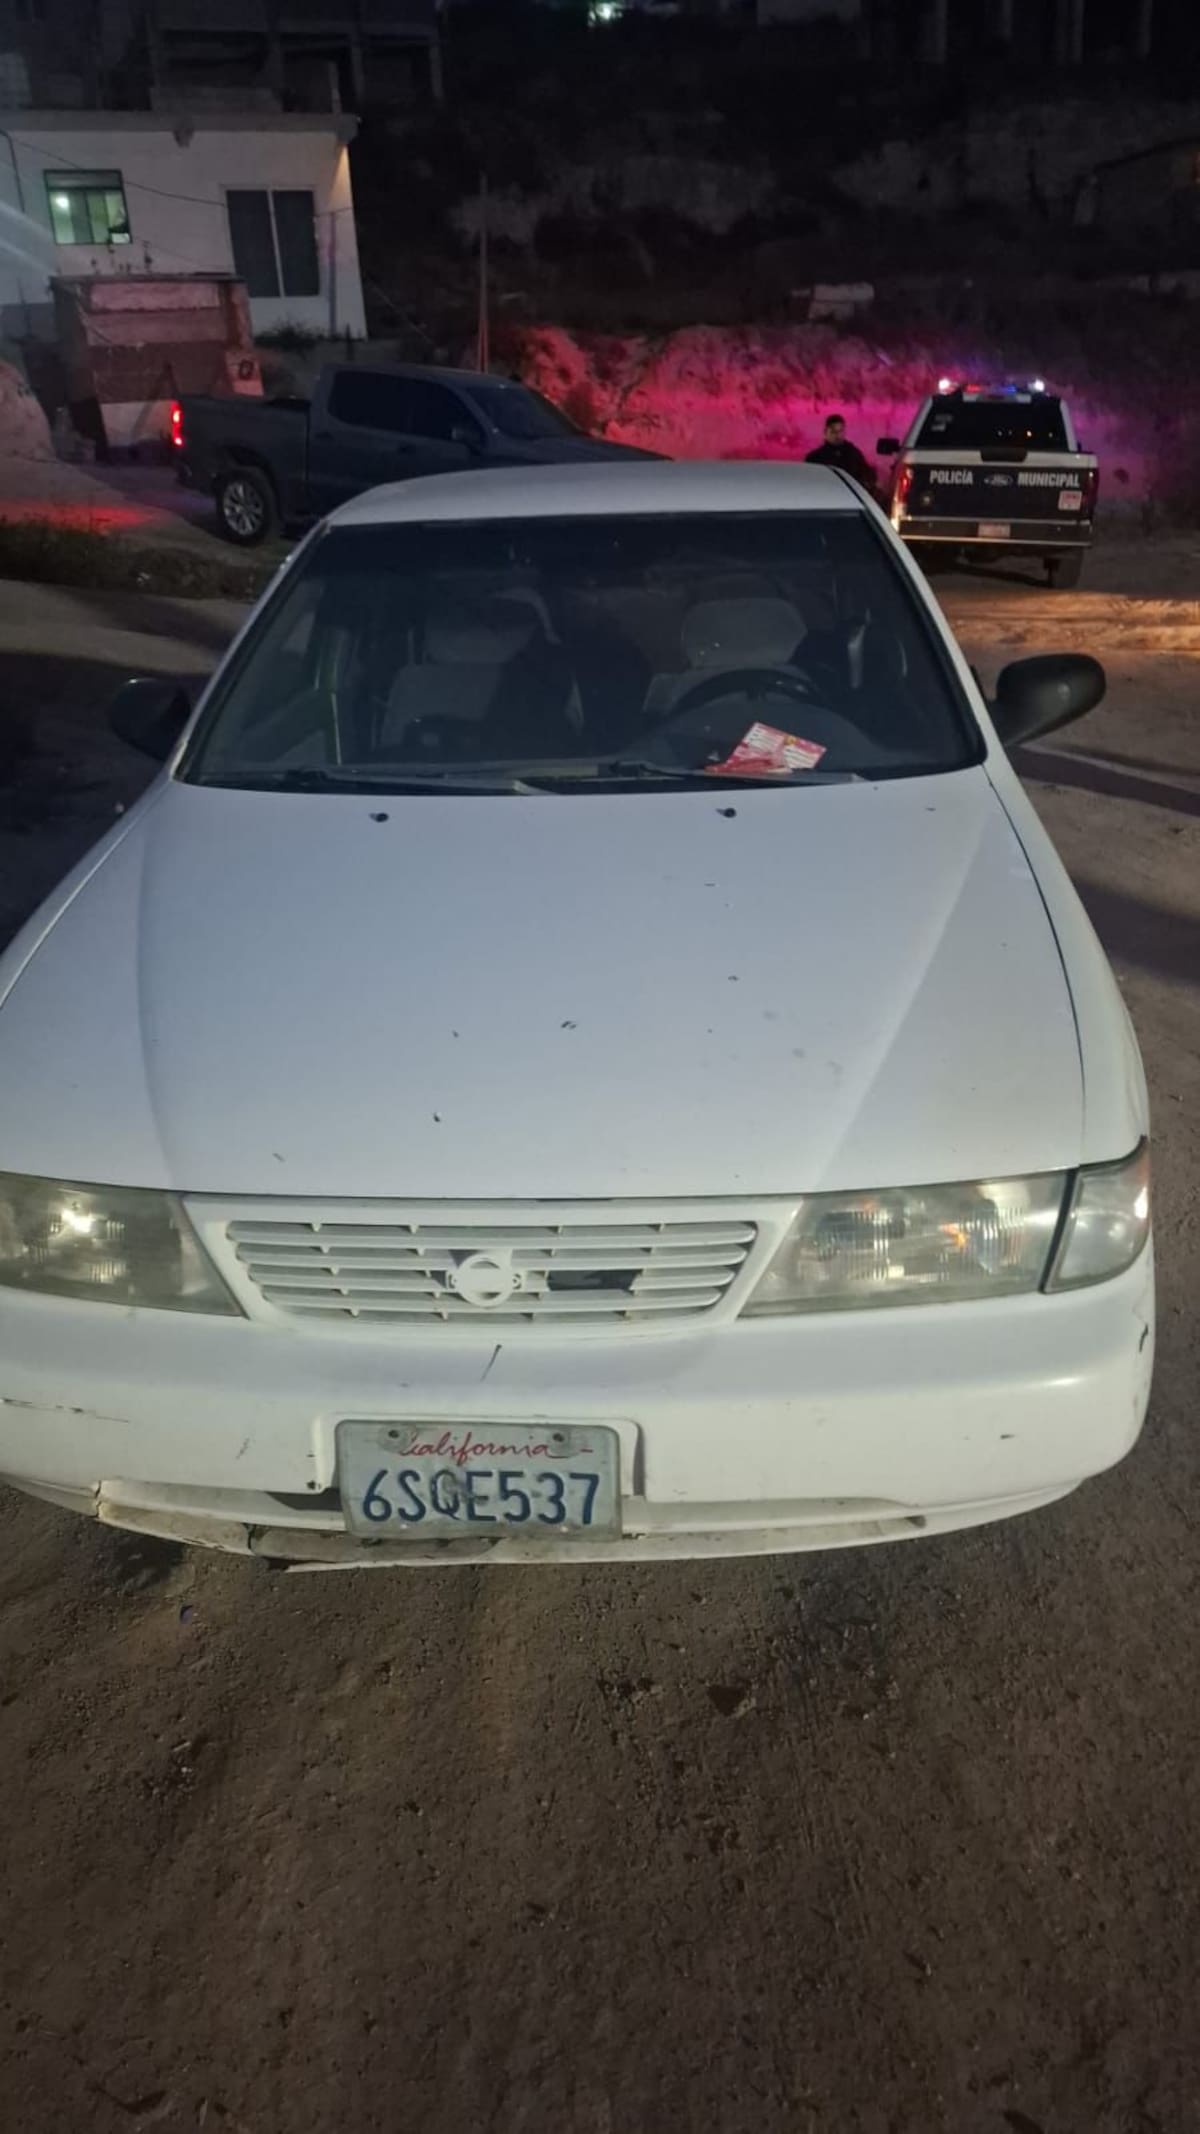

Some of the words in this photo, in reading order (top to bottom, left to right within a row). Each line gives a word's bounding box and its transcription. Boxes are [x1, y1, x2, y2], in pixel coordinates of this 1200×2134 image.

[929, 469, 973, 485] POLICÍA
[1018, 472, 1080, 488] MUNICIPAL
[362, 1469, 600, 1525] 6SQE537
